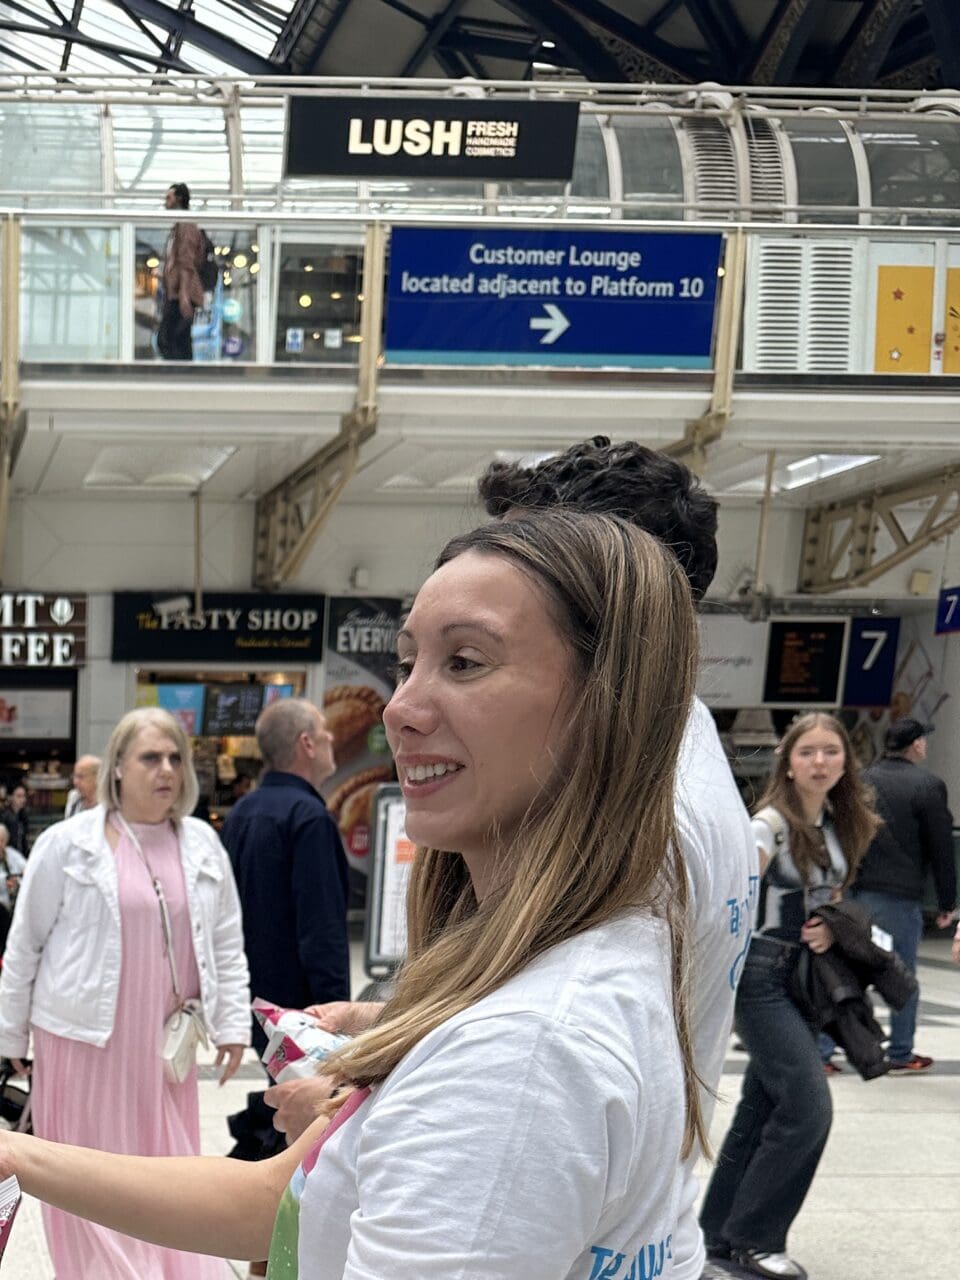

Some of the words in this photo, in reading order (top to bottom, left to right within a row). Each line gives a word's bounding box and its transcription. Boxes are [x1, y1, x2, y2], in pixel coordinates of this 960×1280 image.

[348, 118, 462, 157] LUSH
[466, 120, 519, 137] FRESH
[469, 243, 565, 266] Customer
[569, 245, 642, 271] Lounge
[401, 271, 474, 293] located
[478, 274, 559, 298] adjacent
[565, 275, 587, 296] to
[591, 275, 674, 298] Platform
[679, 277, 704, 298] 10
[247, 609, 318, 631] SHOP
[944, 595, 959, 625] 7
[861, 630, 888, 671] 7
